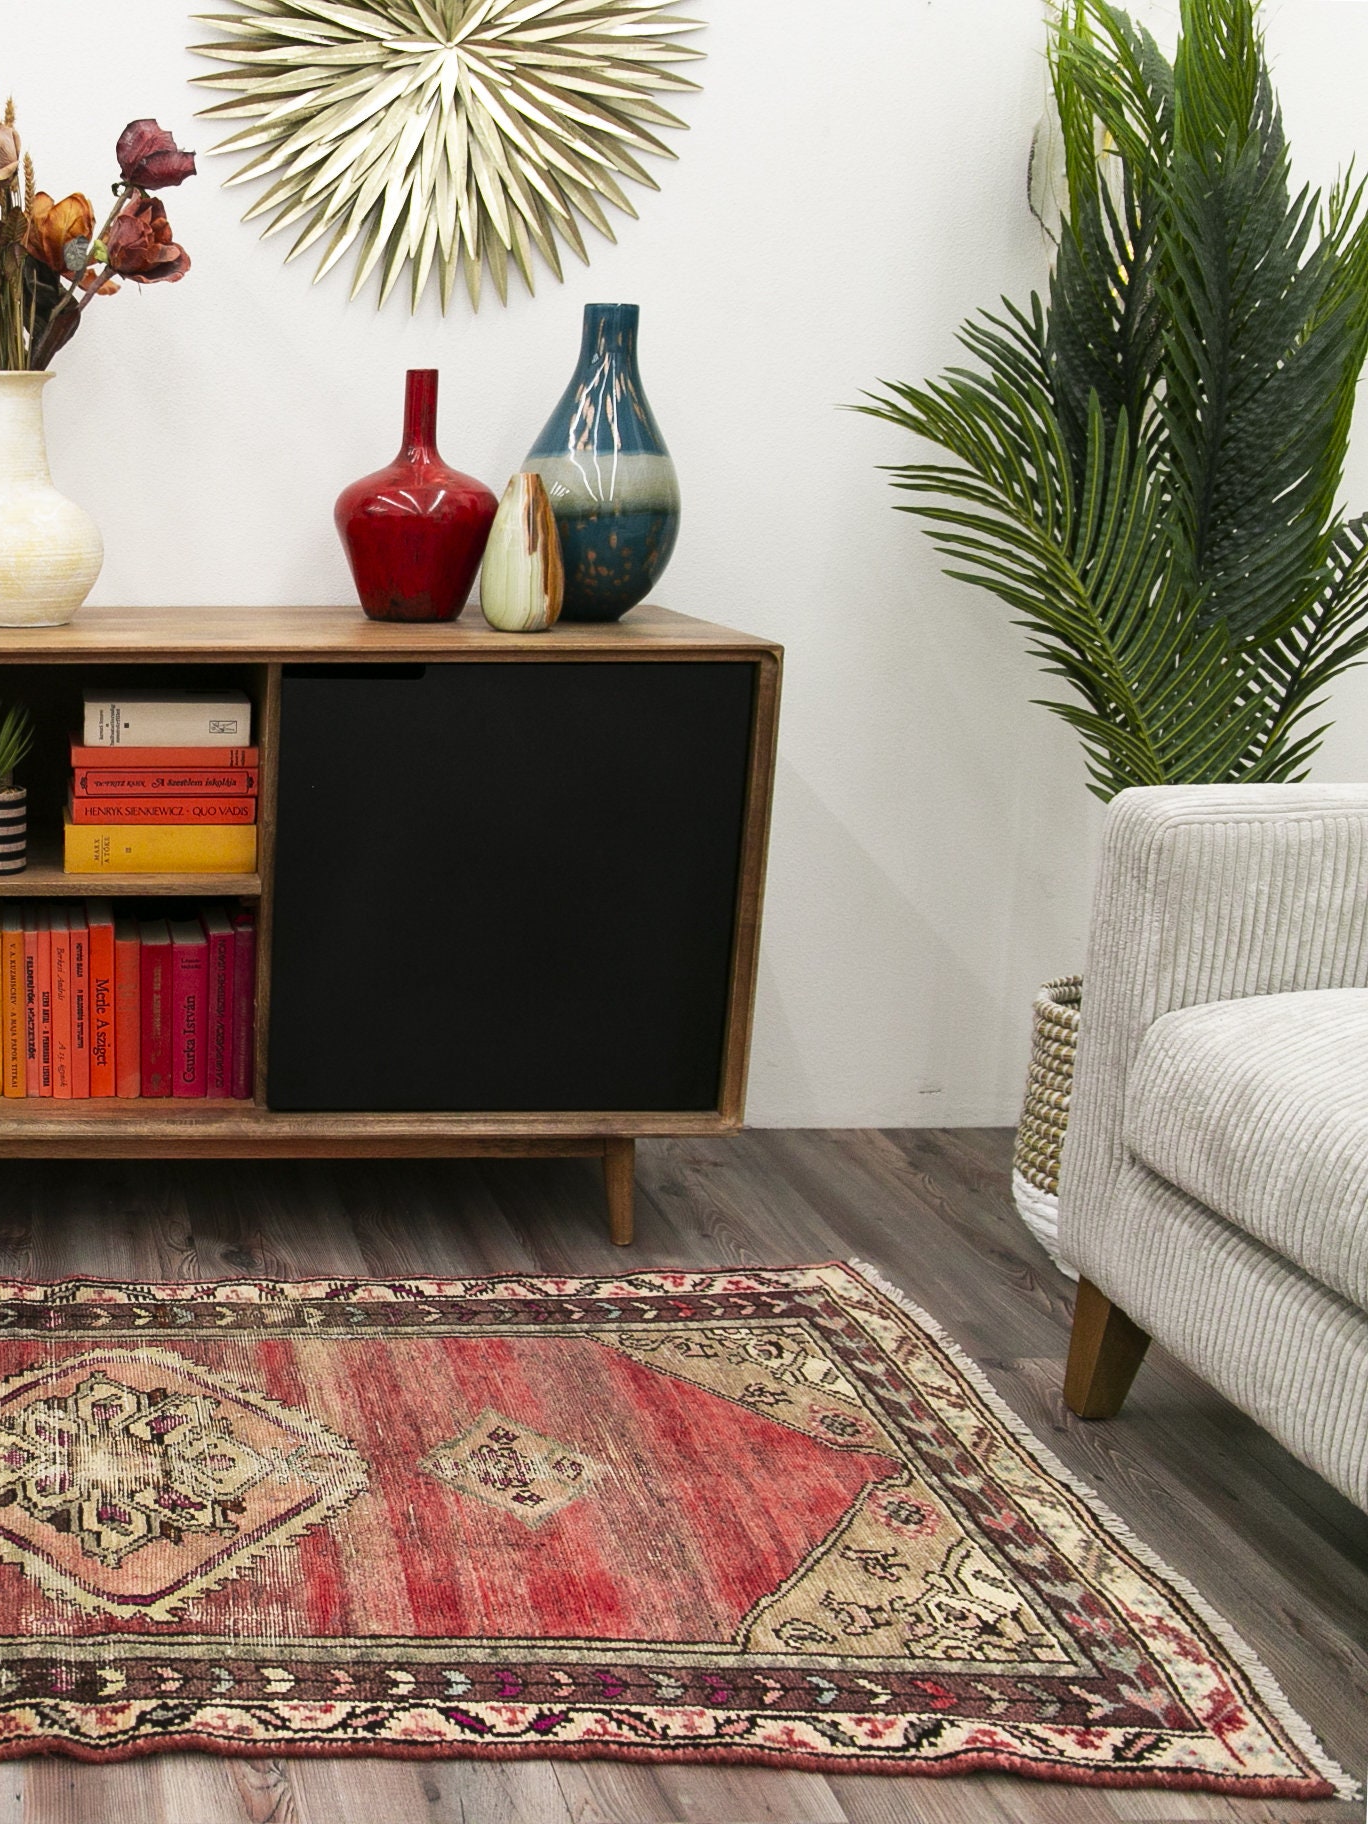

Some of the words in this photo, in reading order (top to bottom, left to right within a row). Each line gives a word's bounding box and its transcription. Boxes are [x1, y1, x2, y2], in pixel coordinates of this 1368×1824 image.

[84, 807, 122, 816] HENRYK
[124, 806, 184, 816] SIENKIEWICZ
[192, 807, 217, 816] QUO
[219, 806, 249, 816] VADIS
[95, 978, 110, 1014] Merle
[96, 1018, 110, 1030] A
[182, 995, 196, 1035] István
[93, 1031, 111, 1066] sziget
[183, 1038, 196, 1083] Csurka
